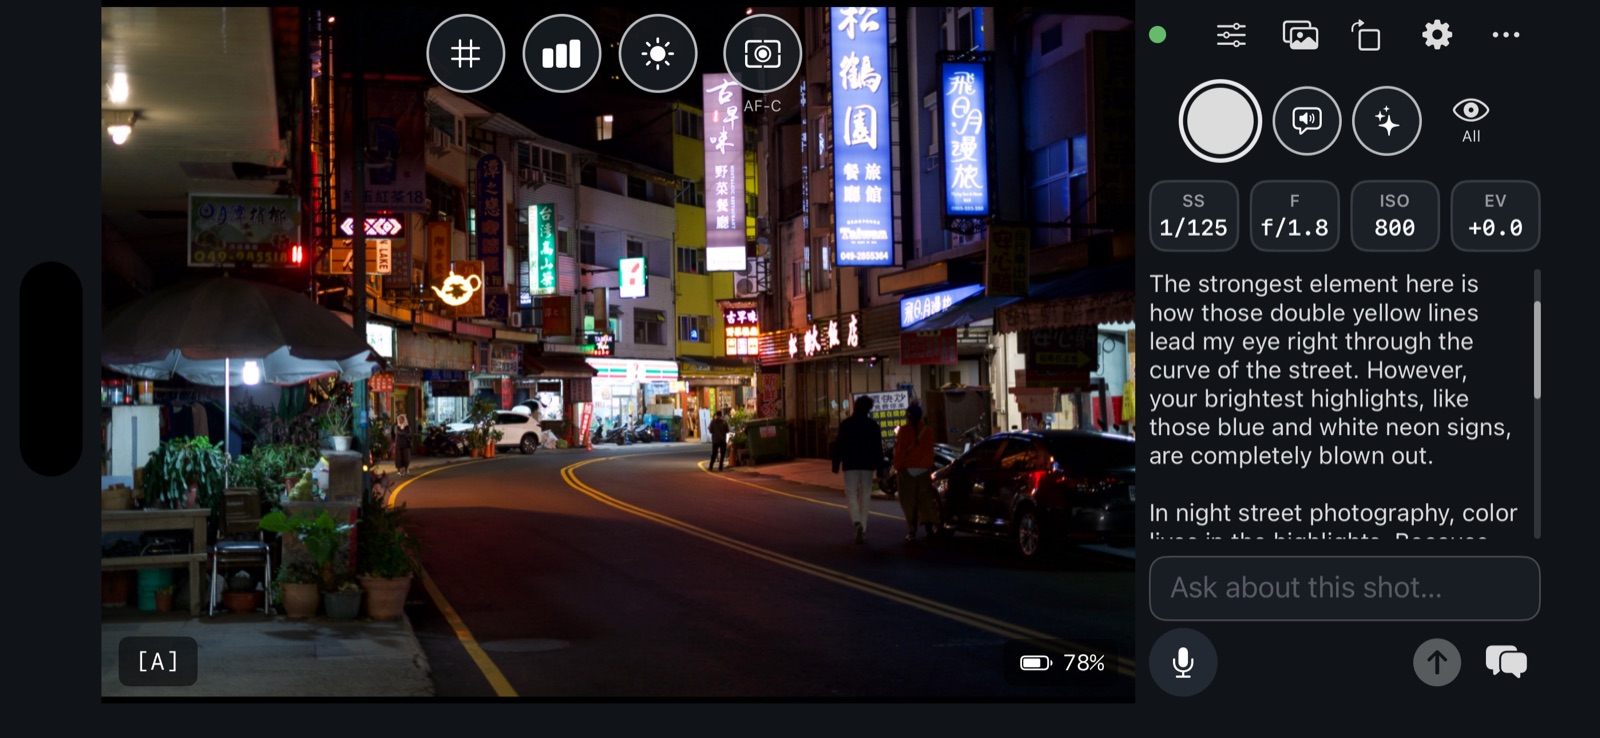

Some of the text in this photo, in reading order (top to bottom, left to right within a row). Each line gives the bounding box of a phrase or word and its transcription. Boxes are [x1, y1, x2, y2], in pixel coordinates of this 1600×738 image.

[706, 78, 740, 155] 古早味
[379, 249, 388, 270] LAKE
